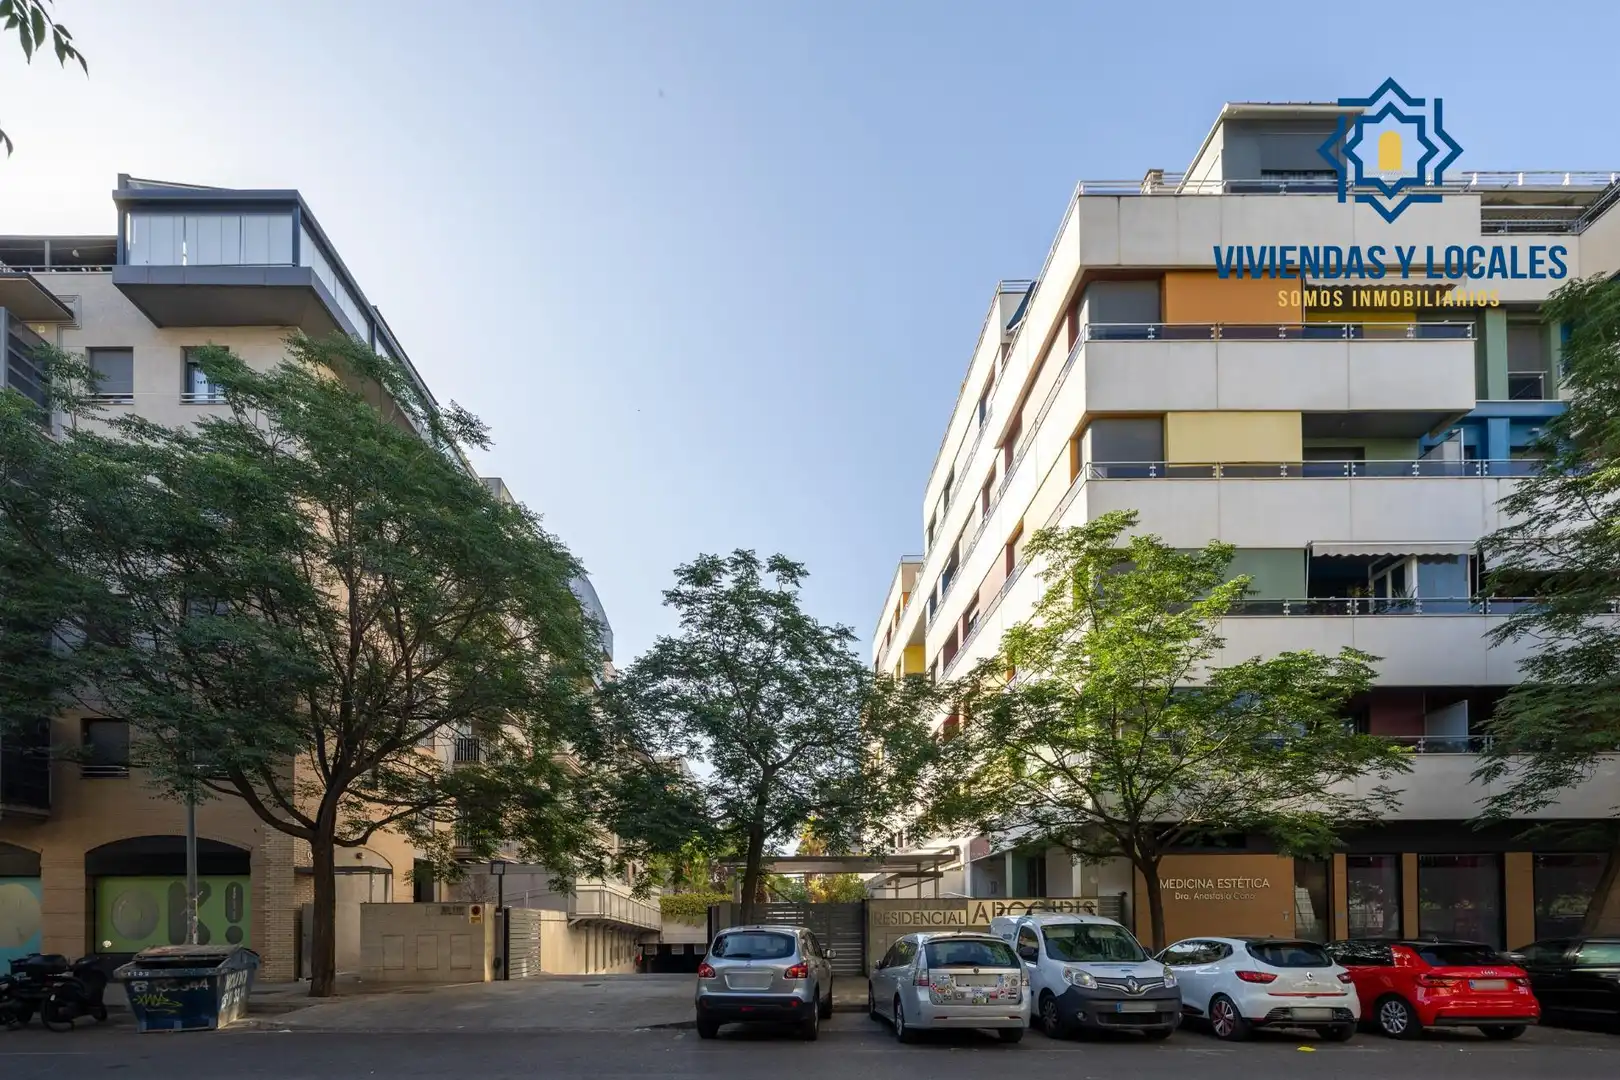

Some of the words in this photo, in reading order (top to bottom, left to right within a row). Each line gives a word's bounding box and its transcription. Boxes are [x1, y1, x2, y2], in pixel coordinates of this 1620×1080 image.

[1160, 878, 1215, 889] MEDICINA
[1217, 876, 1270, 889] ESTÉTICA
[1174, 892, 1192, 900] Dra.
[1194, 892, 1233, 901] Anastasia
[873, 911, 965, 925] RESIDENCIAL
